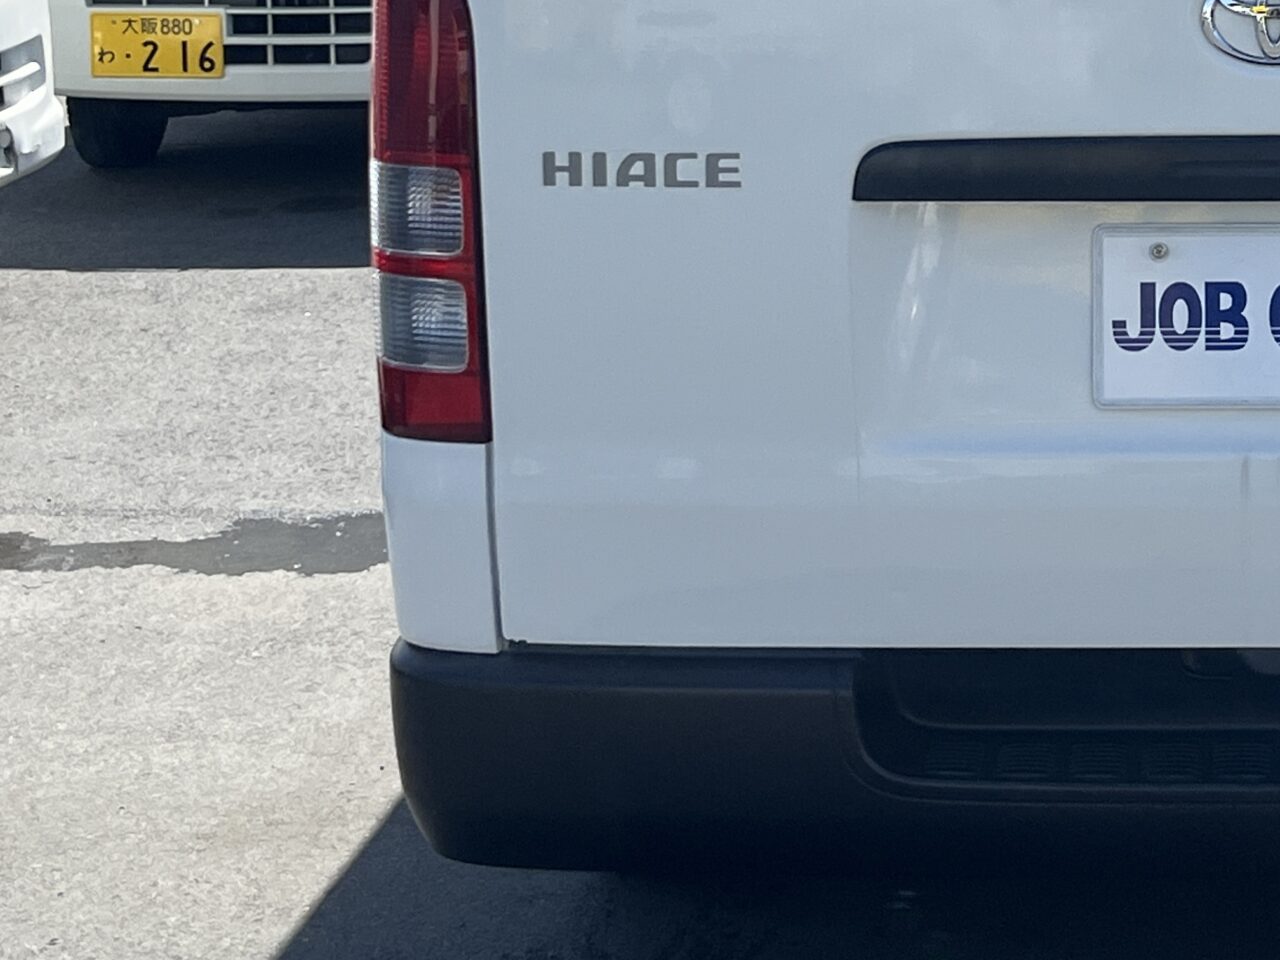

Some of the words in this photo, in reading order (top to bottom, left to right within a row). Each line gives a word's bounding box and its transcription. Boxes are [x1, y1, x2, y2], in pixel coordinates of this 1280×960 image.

[121, 18, 193, 36] 大阪880
[98, 47, 116, 64] わ
[542, 151, 742, 188] HIACE
[1111, 281, 1250, 352] JOB
